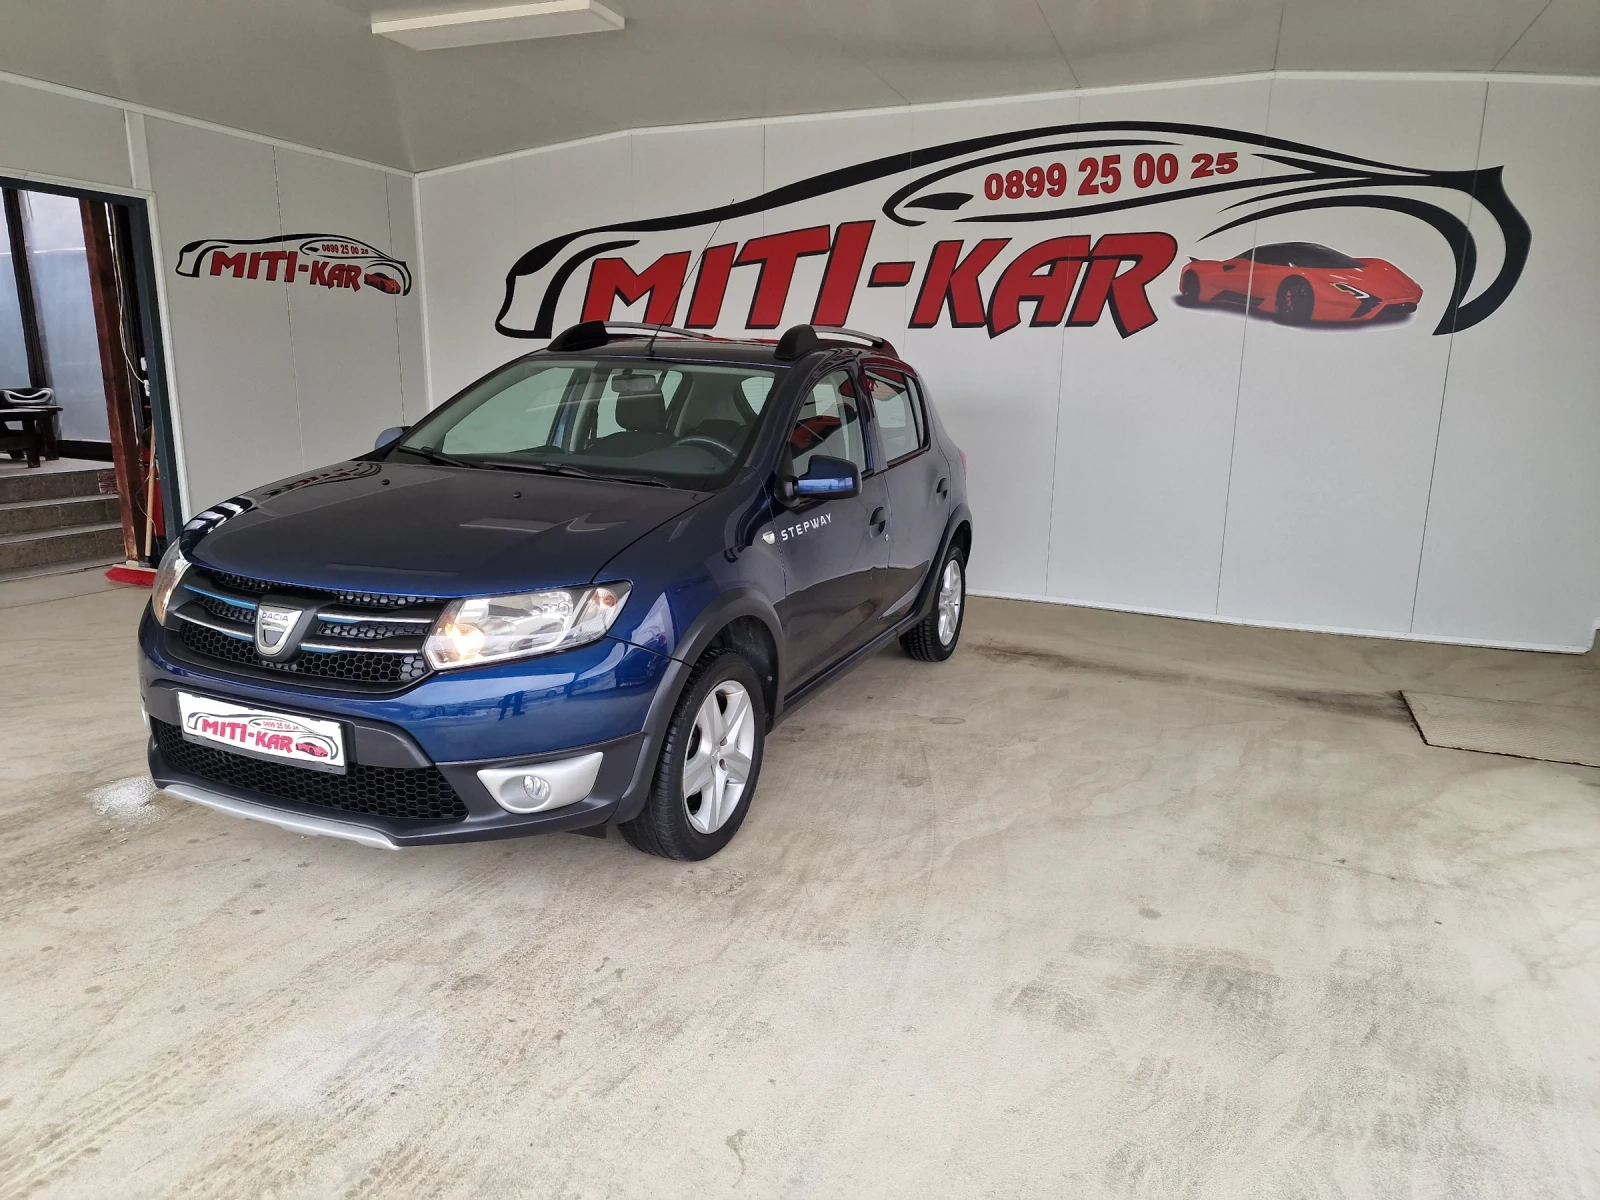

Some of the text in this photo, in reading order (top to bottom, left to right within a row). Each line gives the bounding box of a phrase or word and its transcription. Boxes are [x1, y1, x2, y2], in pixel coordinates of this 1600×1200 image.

[984, 151, 1239, 200] 0899 25 00 25
[321, 244, 339, 254] 0899
[340, 244, 350, 255] 25
[350, 245, 360, 255] 00
[209, 250, 362, 292] MITI-KAR
[580, 220, 1178, 339] MITI-KAR
[780, 513, 832, 541] STEPWAY
[261, 611, 289, 622] DACIA
[201, 718, 294, 754] MITI-KAR
